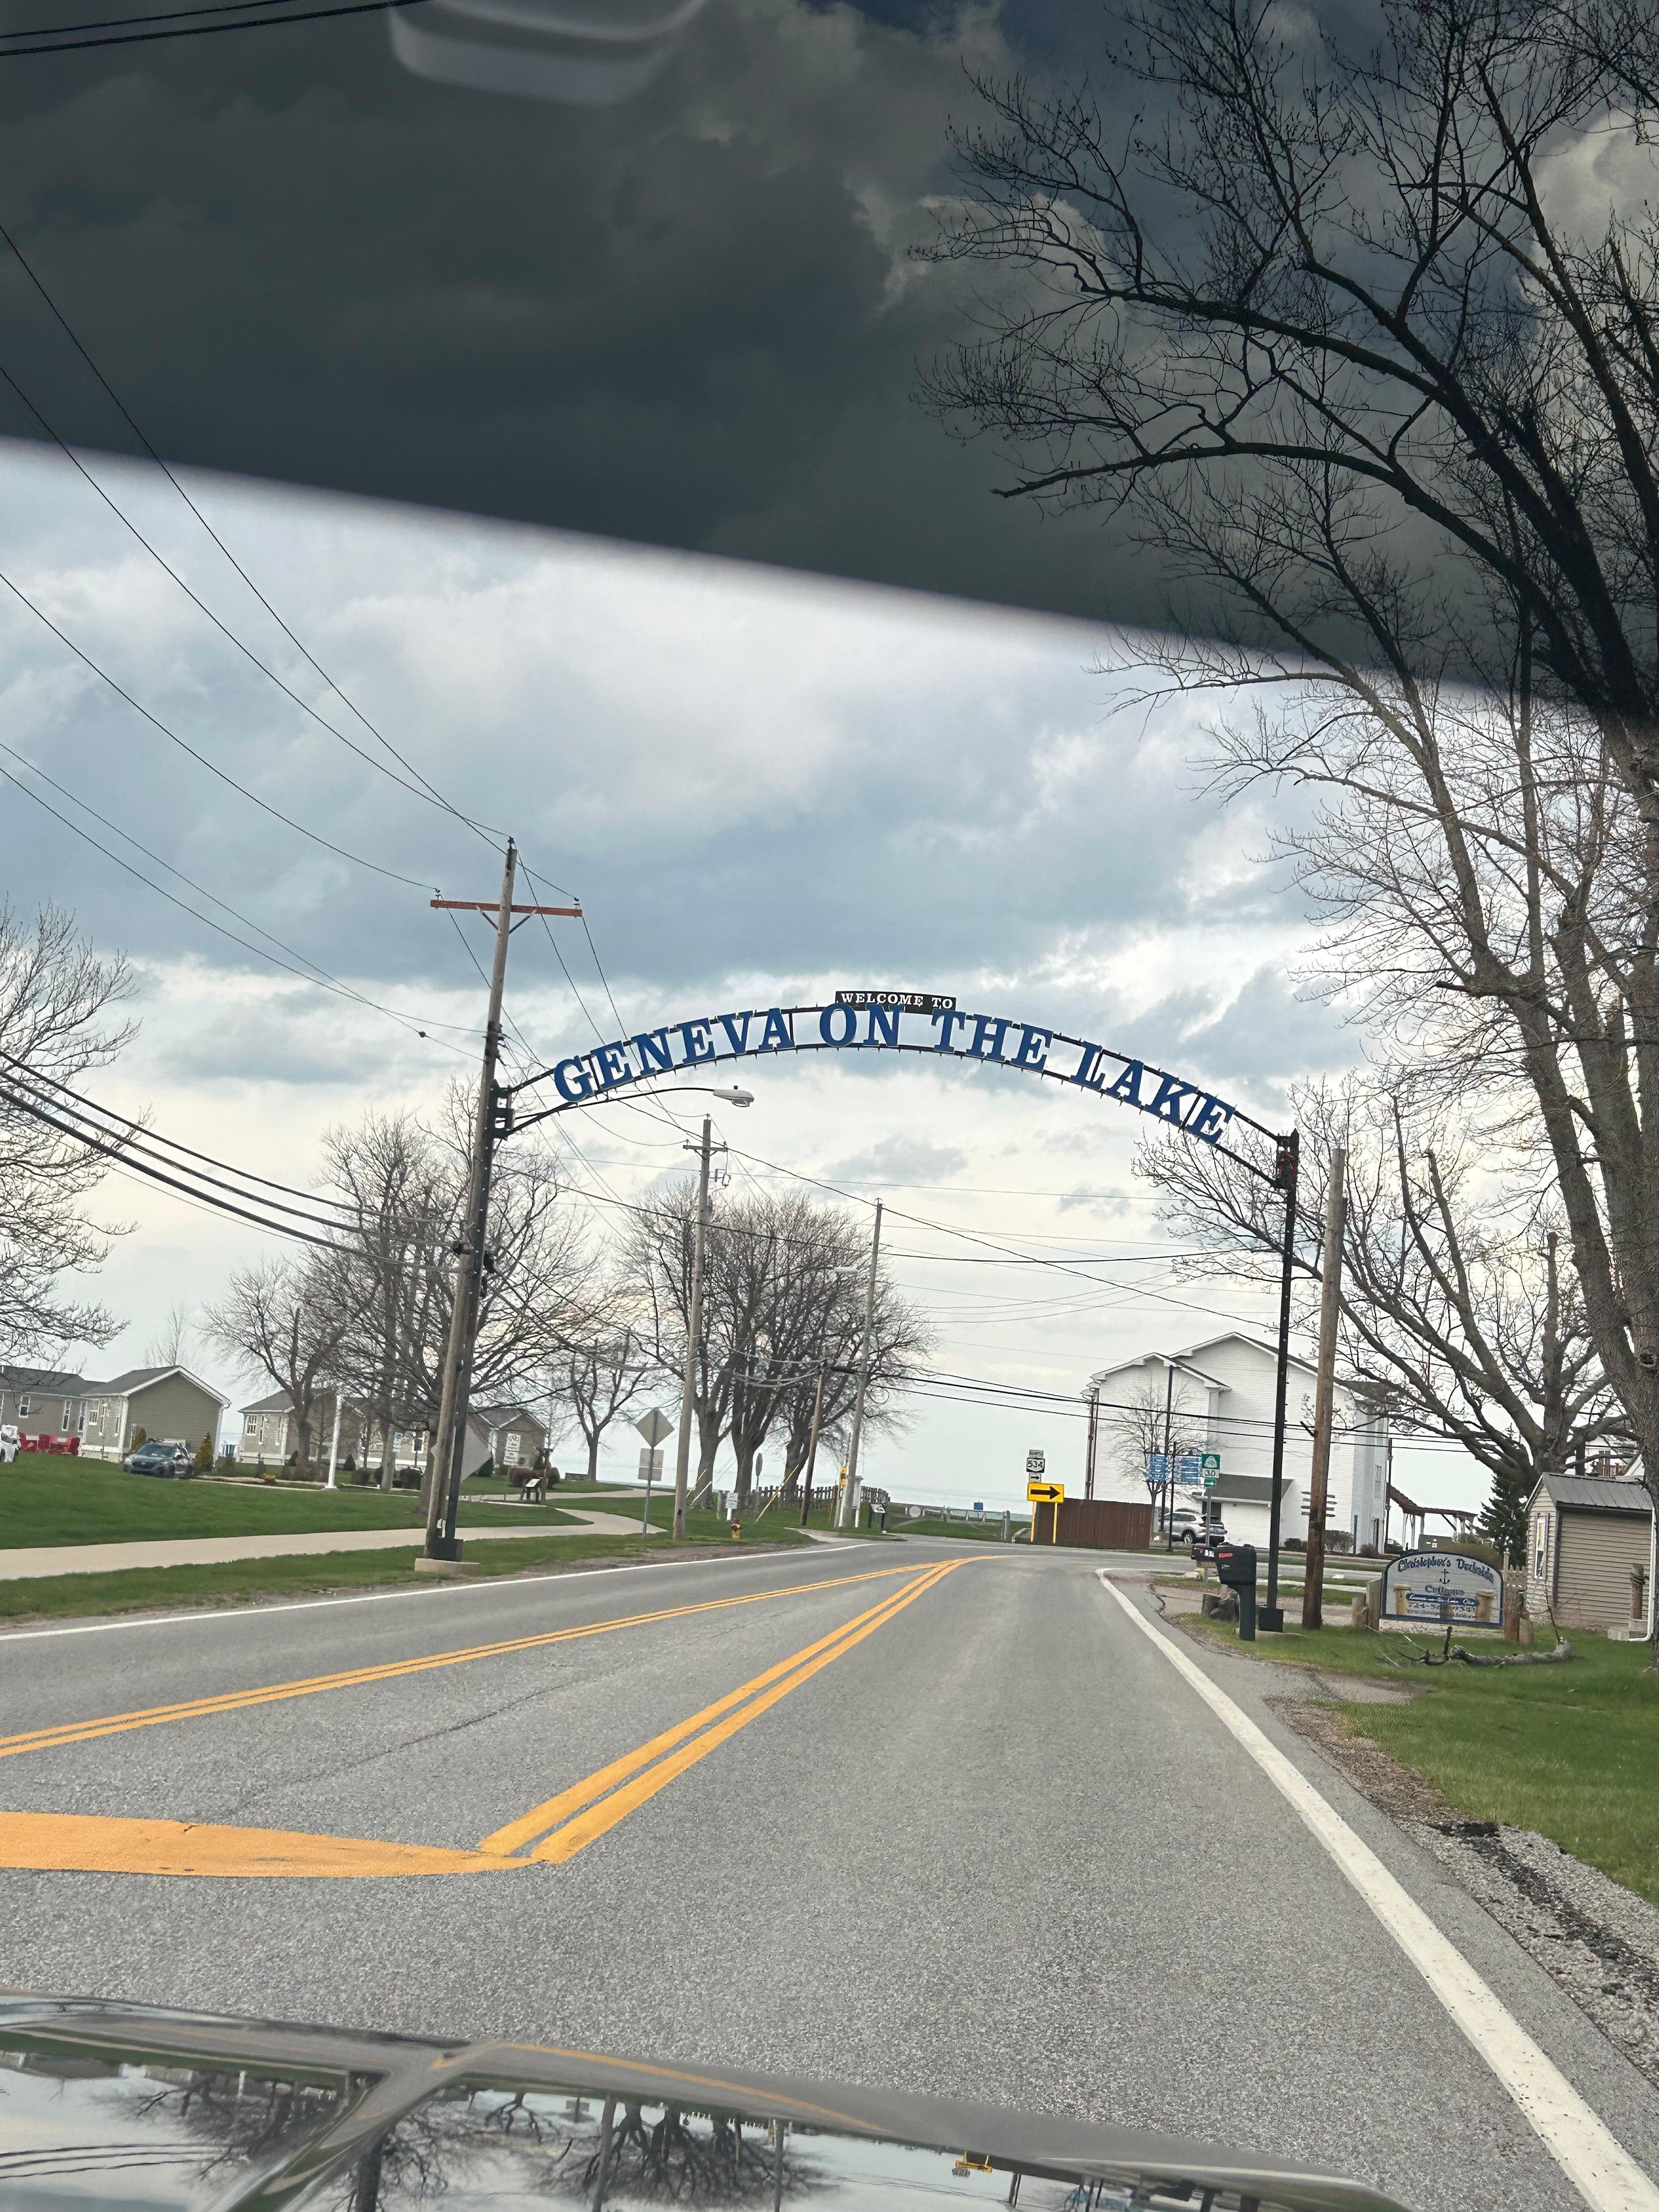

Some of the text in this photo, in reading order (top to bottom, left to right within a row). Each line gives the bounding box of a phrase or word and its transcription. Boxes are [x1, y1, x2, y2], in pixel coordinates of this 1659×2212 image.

[840, 993, 953, 1008] WELCOME TO
[553, 1002, 1236, 1145] GENEVA ON THE LAKE
[1028, 1460, 1043, 1469] 534
